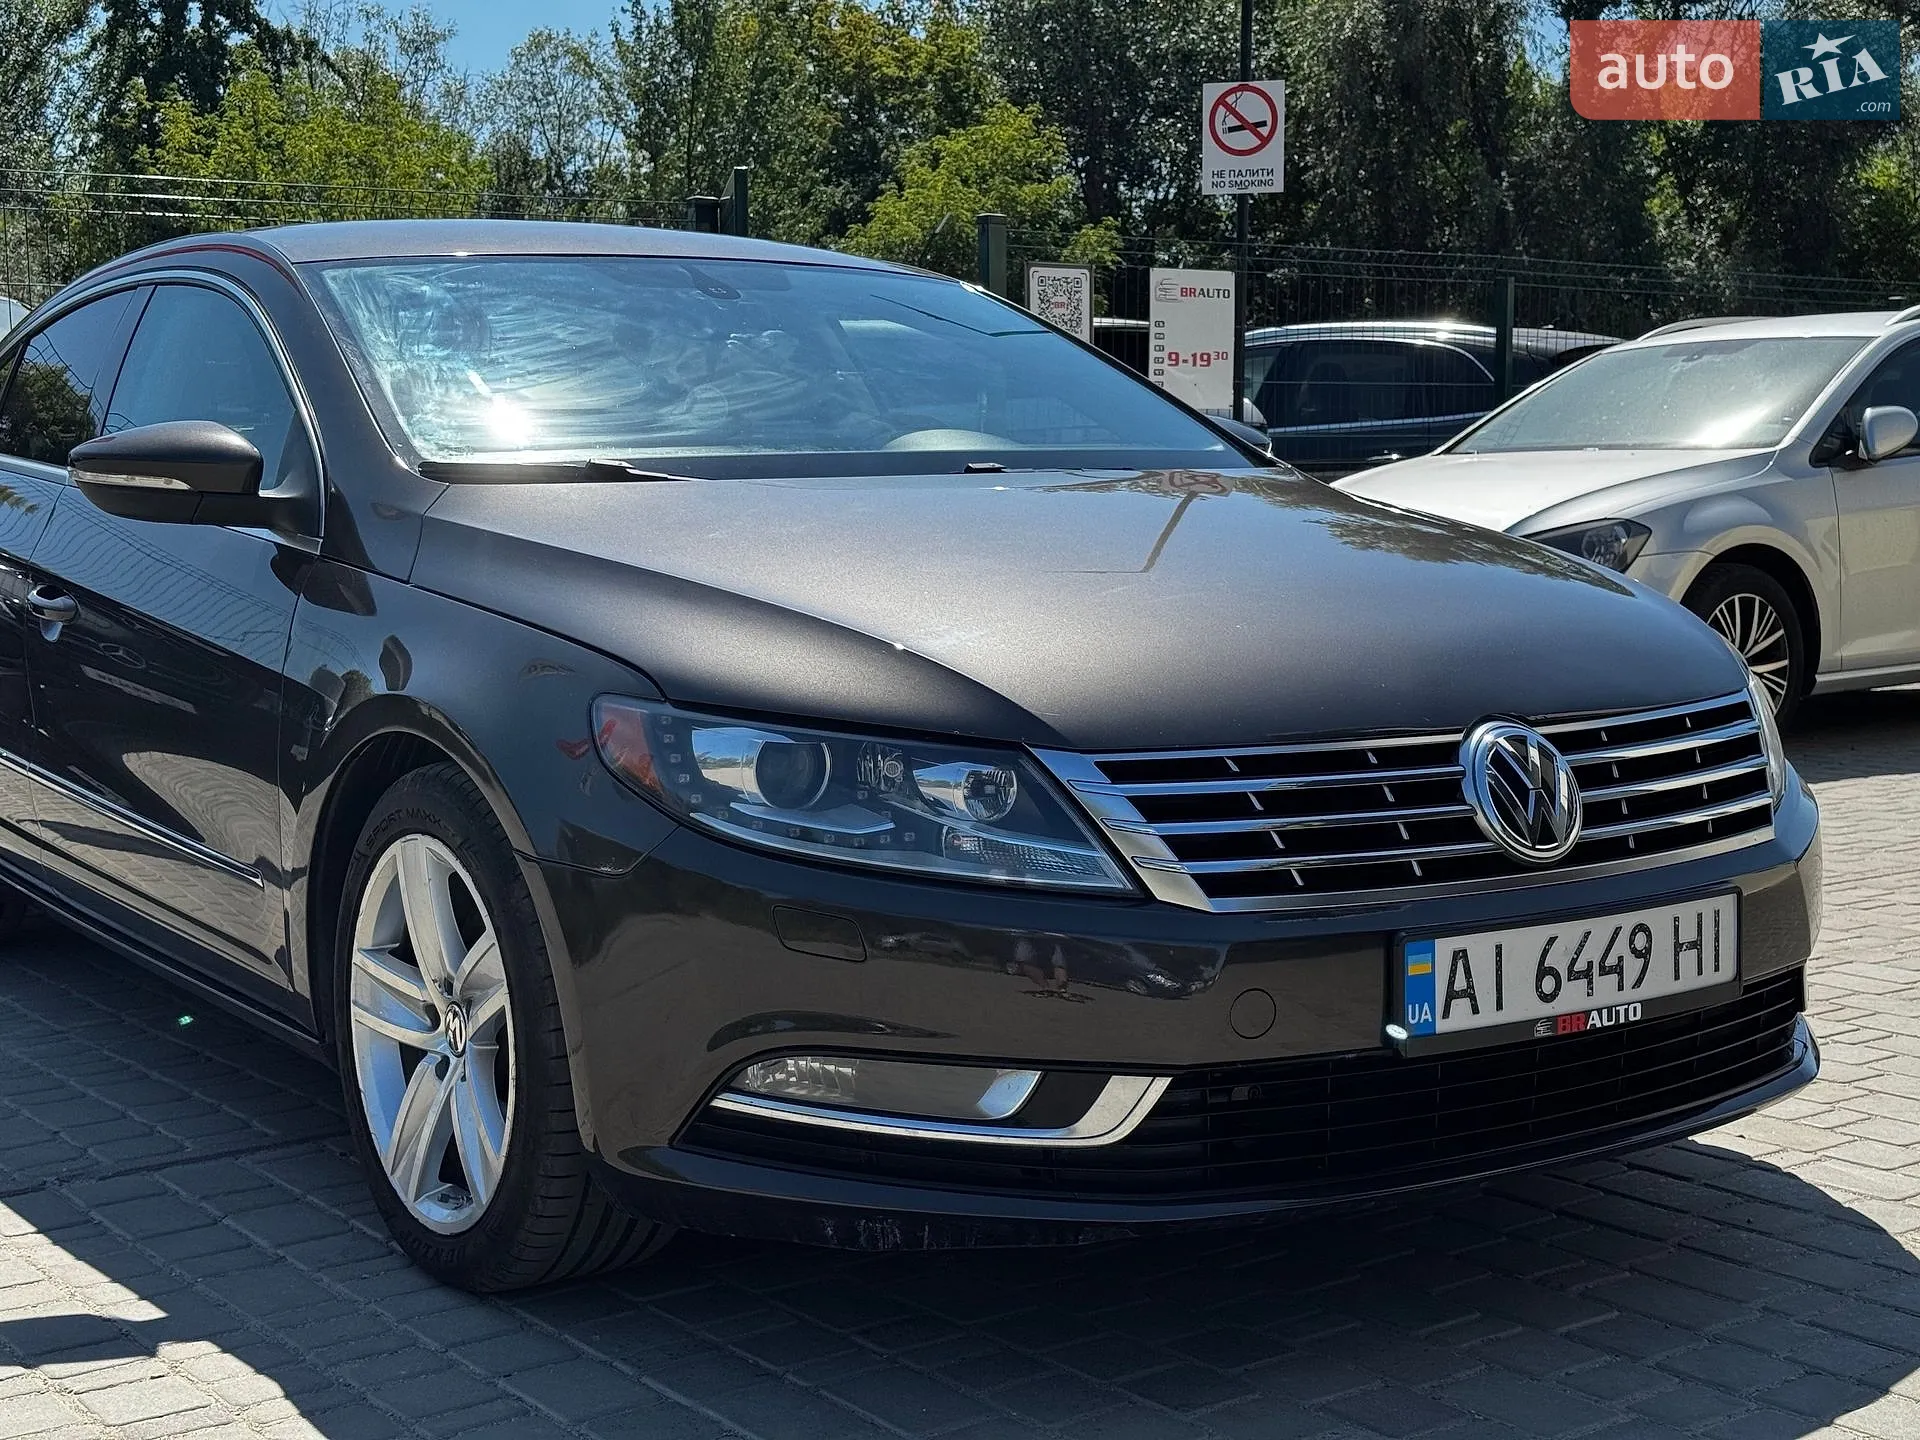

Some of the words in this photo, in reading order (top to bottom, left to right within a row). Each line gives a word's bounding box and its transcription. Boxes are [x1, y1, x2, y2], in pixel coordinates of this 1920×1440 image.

[1211, 169, 1226, 179] НЕ
[1228, 167, 1274, 179] ПАЛИТИ
[1211, 180, 1226, 189] NO
[1228, 179, 1274, 190] SMOKING
[1179, 286, 1231, 299] BRAUTO
[1441, 943, 1505, 1020] AI
[1534, 922, 1654, 1004] 6449
[1673, 908, 1721, 981] HI
[1407, 1001, 1433, 1025] UA
[1556, 1003, 1642, 1034] BRAUTO
